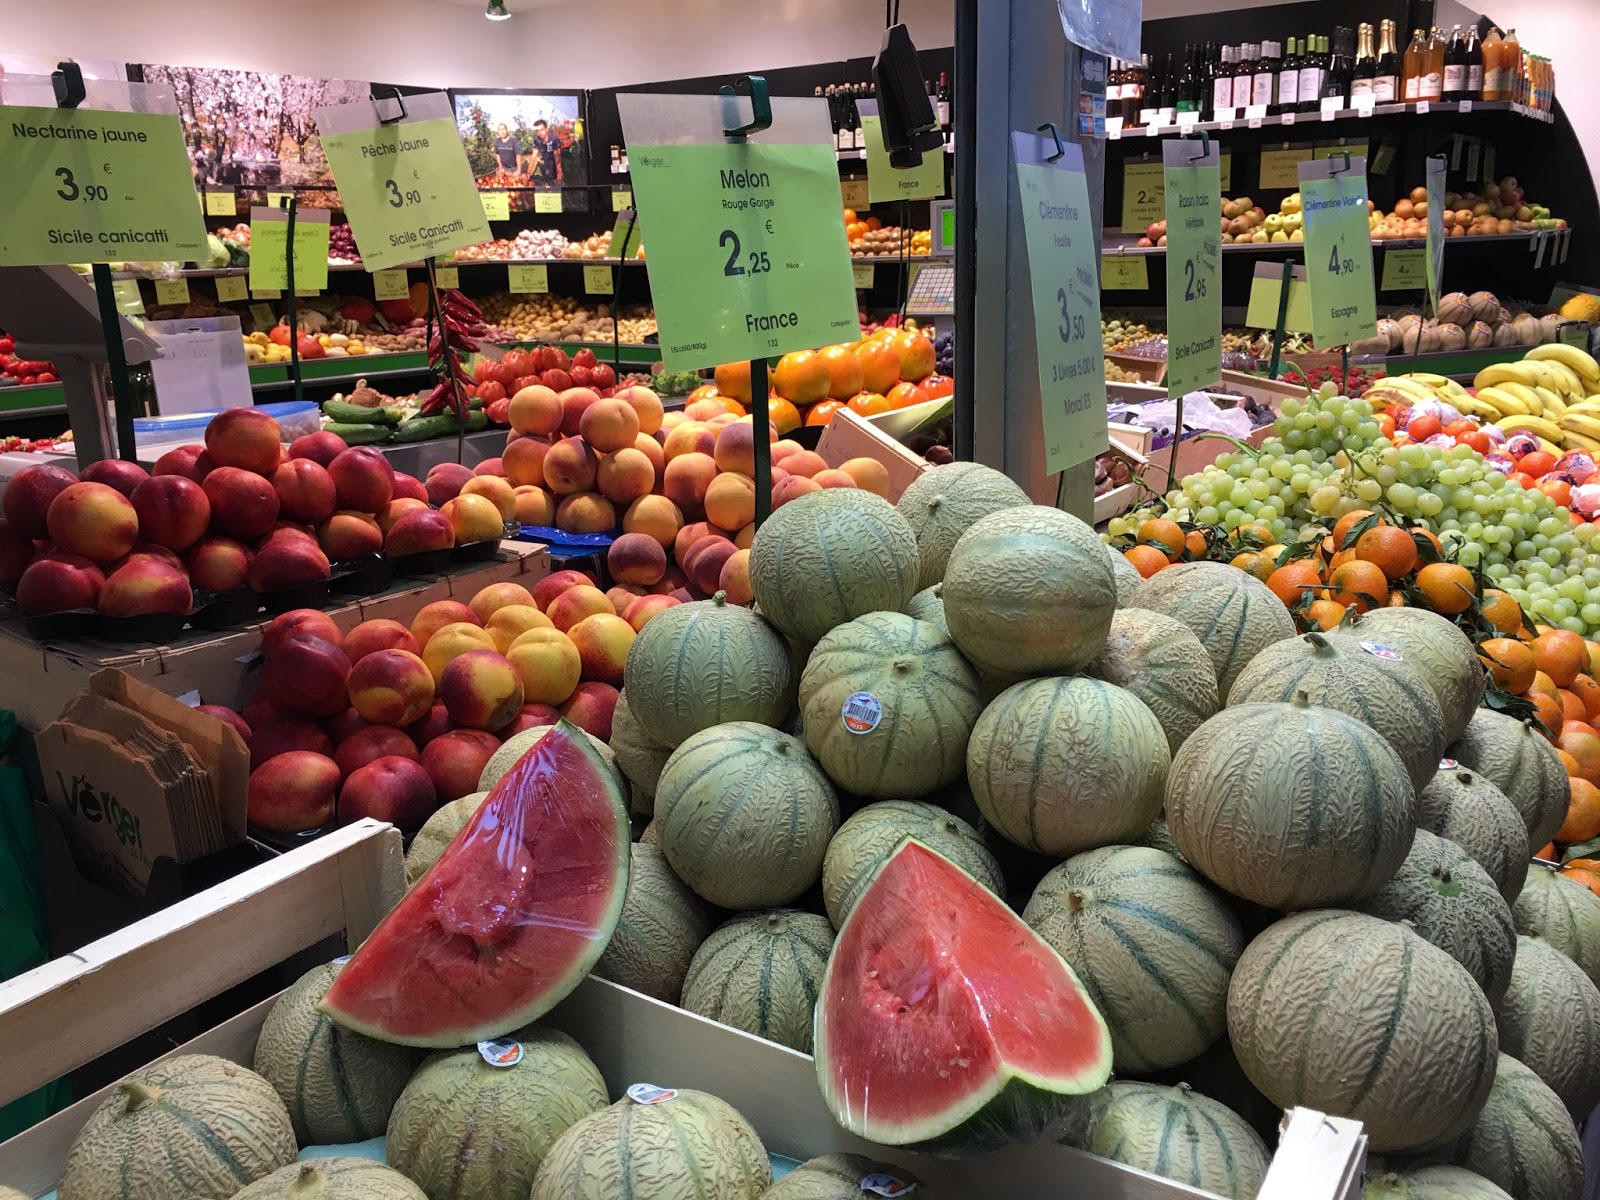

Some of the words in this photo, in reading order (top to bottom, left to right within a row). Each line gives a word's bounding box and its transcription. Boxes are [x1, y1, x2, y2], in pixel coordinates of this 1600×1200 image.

[12, 123, 97, 140] Nectarine
[102, 127, 147, 143] jaune
[361, 143, 397, 158] Pêche
[399, 138, 429, 152] Jaune
[720, 169, 770, 189] Melon
[898, 181, 919, 189] France
[722, 199, 748, 210] Rouge
[749, 198, 775, 209] Gorge
[48, 229, 93, 244] Sicile
[98, 229, 169, 243] canicatti
[389, 232, 417, 247] Sicile
[419, 219, 464, 239] Canicatti
[719, 229, 771, 277] 2,25
[745, 312, 798, 333] France
[1331, 306, 1358, 319] Espagne
[767, 338, 779, 348] 132
[1176, 345, 1189, 360] Sicile
[1191, 336, 1215, 355] Canicatti
